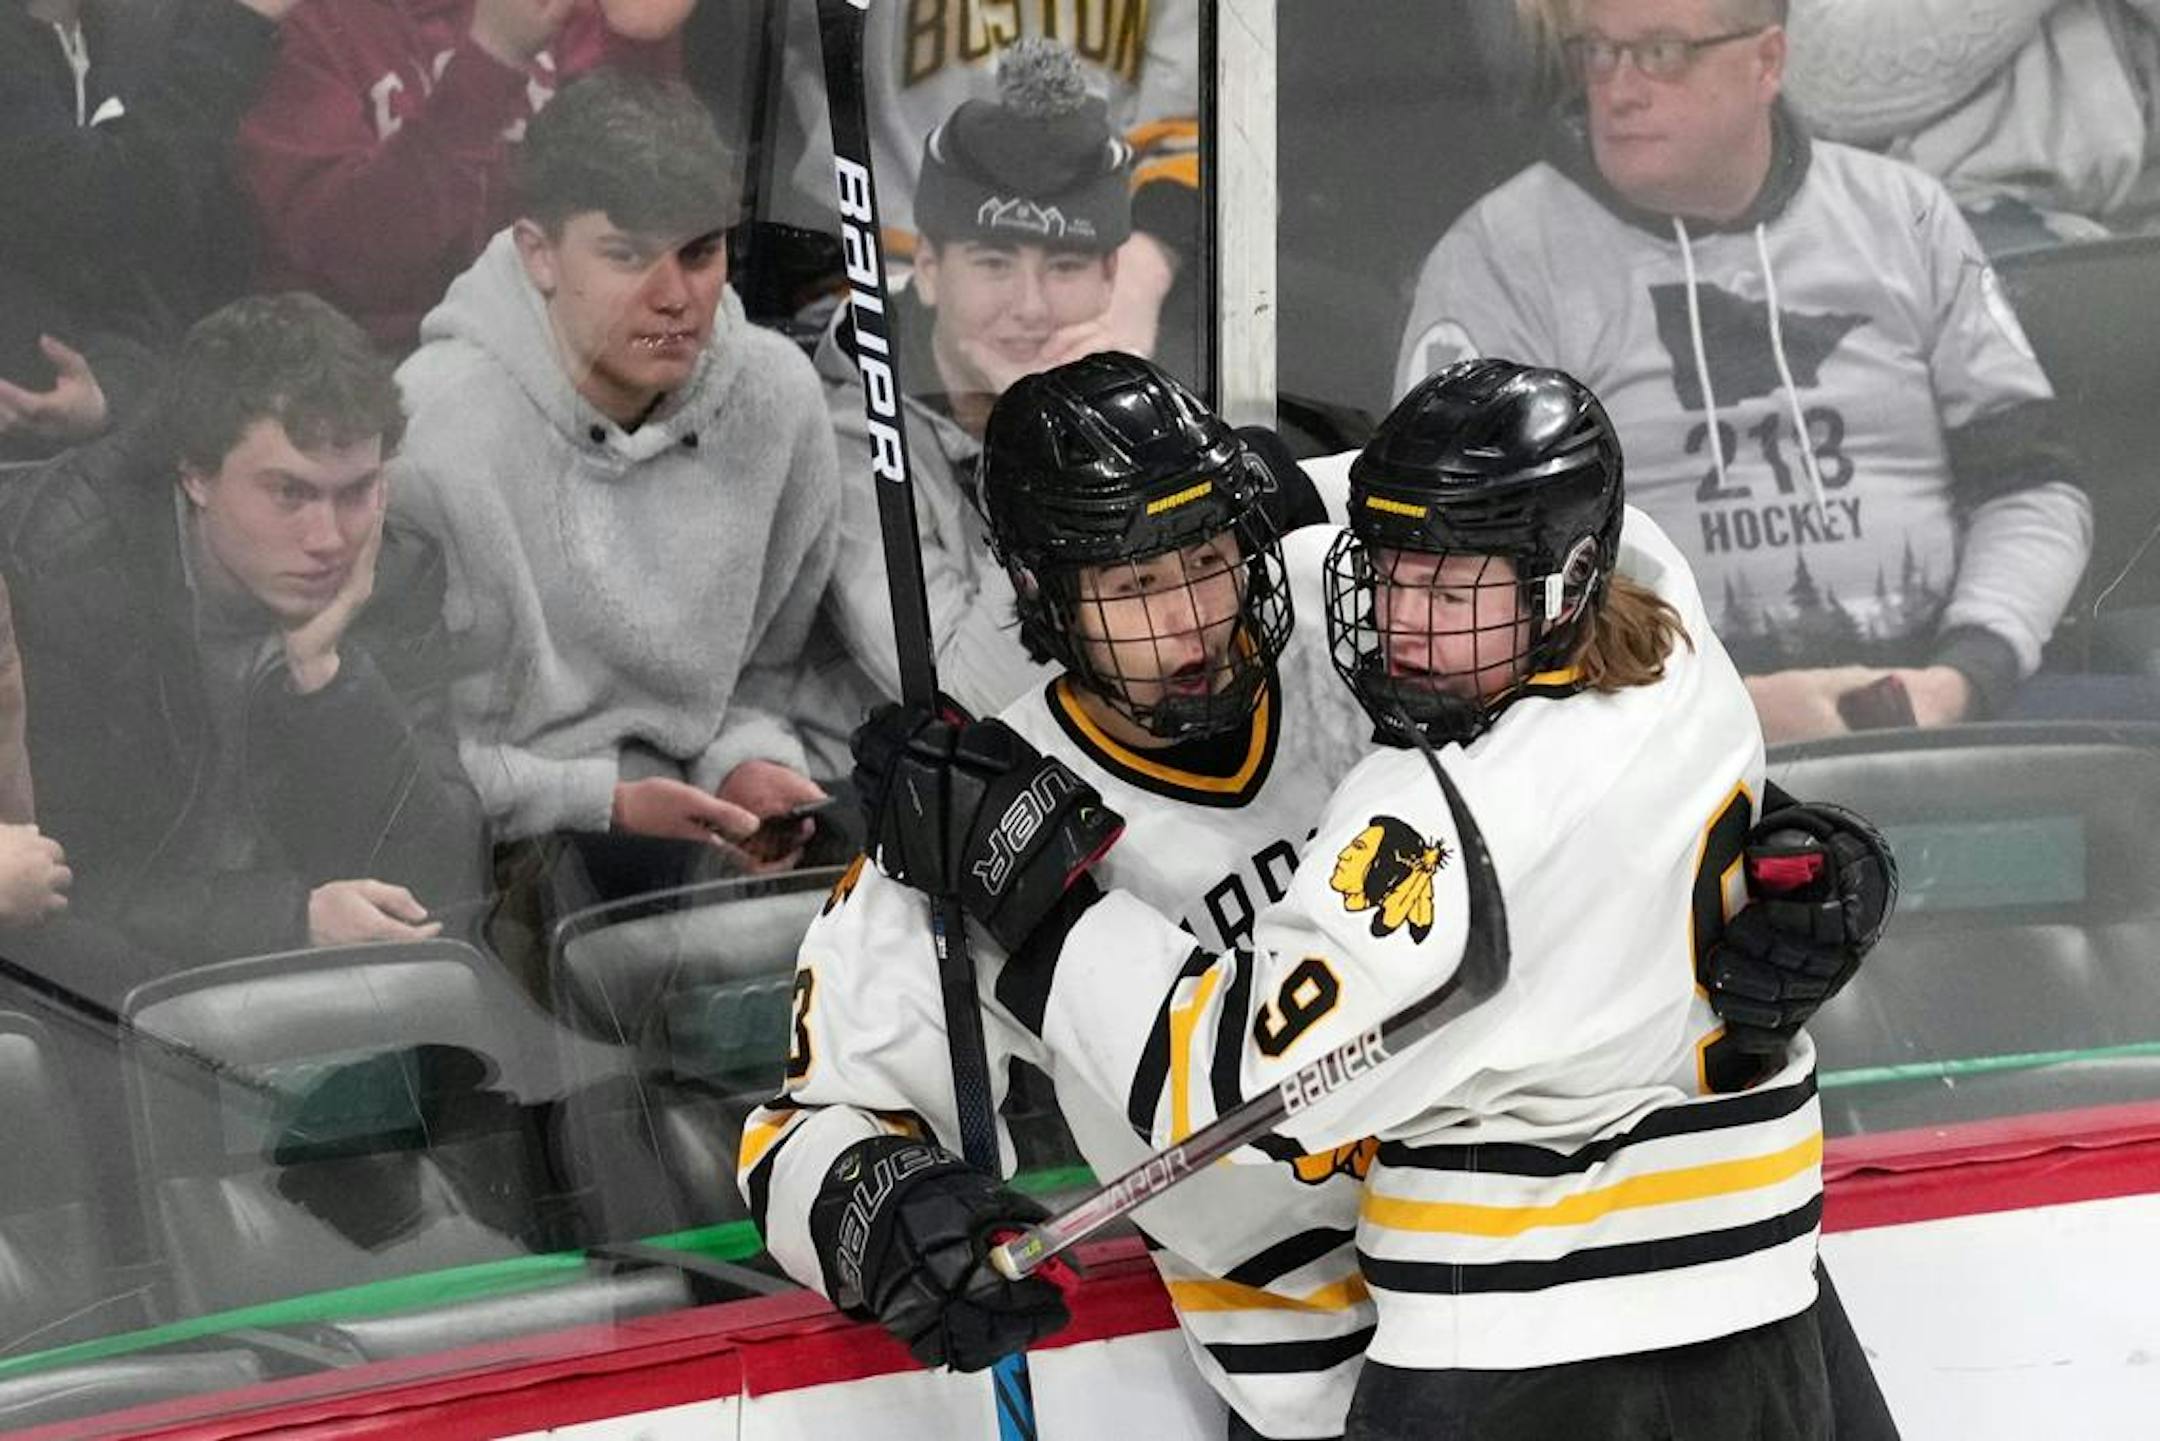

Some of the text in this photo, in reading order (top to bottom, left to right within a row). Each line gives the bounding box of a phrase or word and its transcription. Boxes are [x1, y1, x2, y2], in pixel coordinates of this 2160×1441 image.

[1684, 406, 1854, 503] 218
[1701, 497, 1862, 553] HOCKEY
[1281, 1023, 1393, 1117] BAUER
